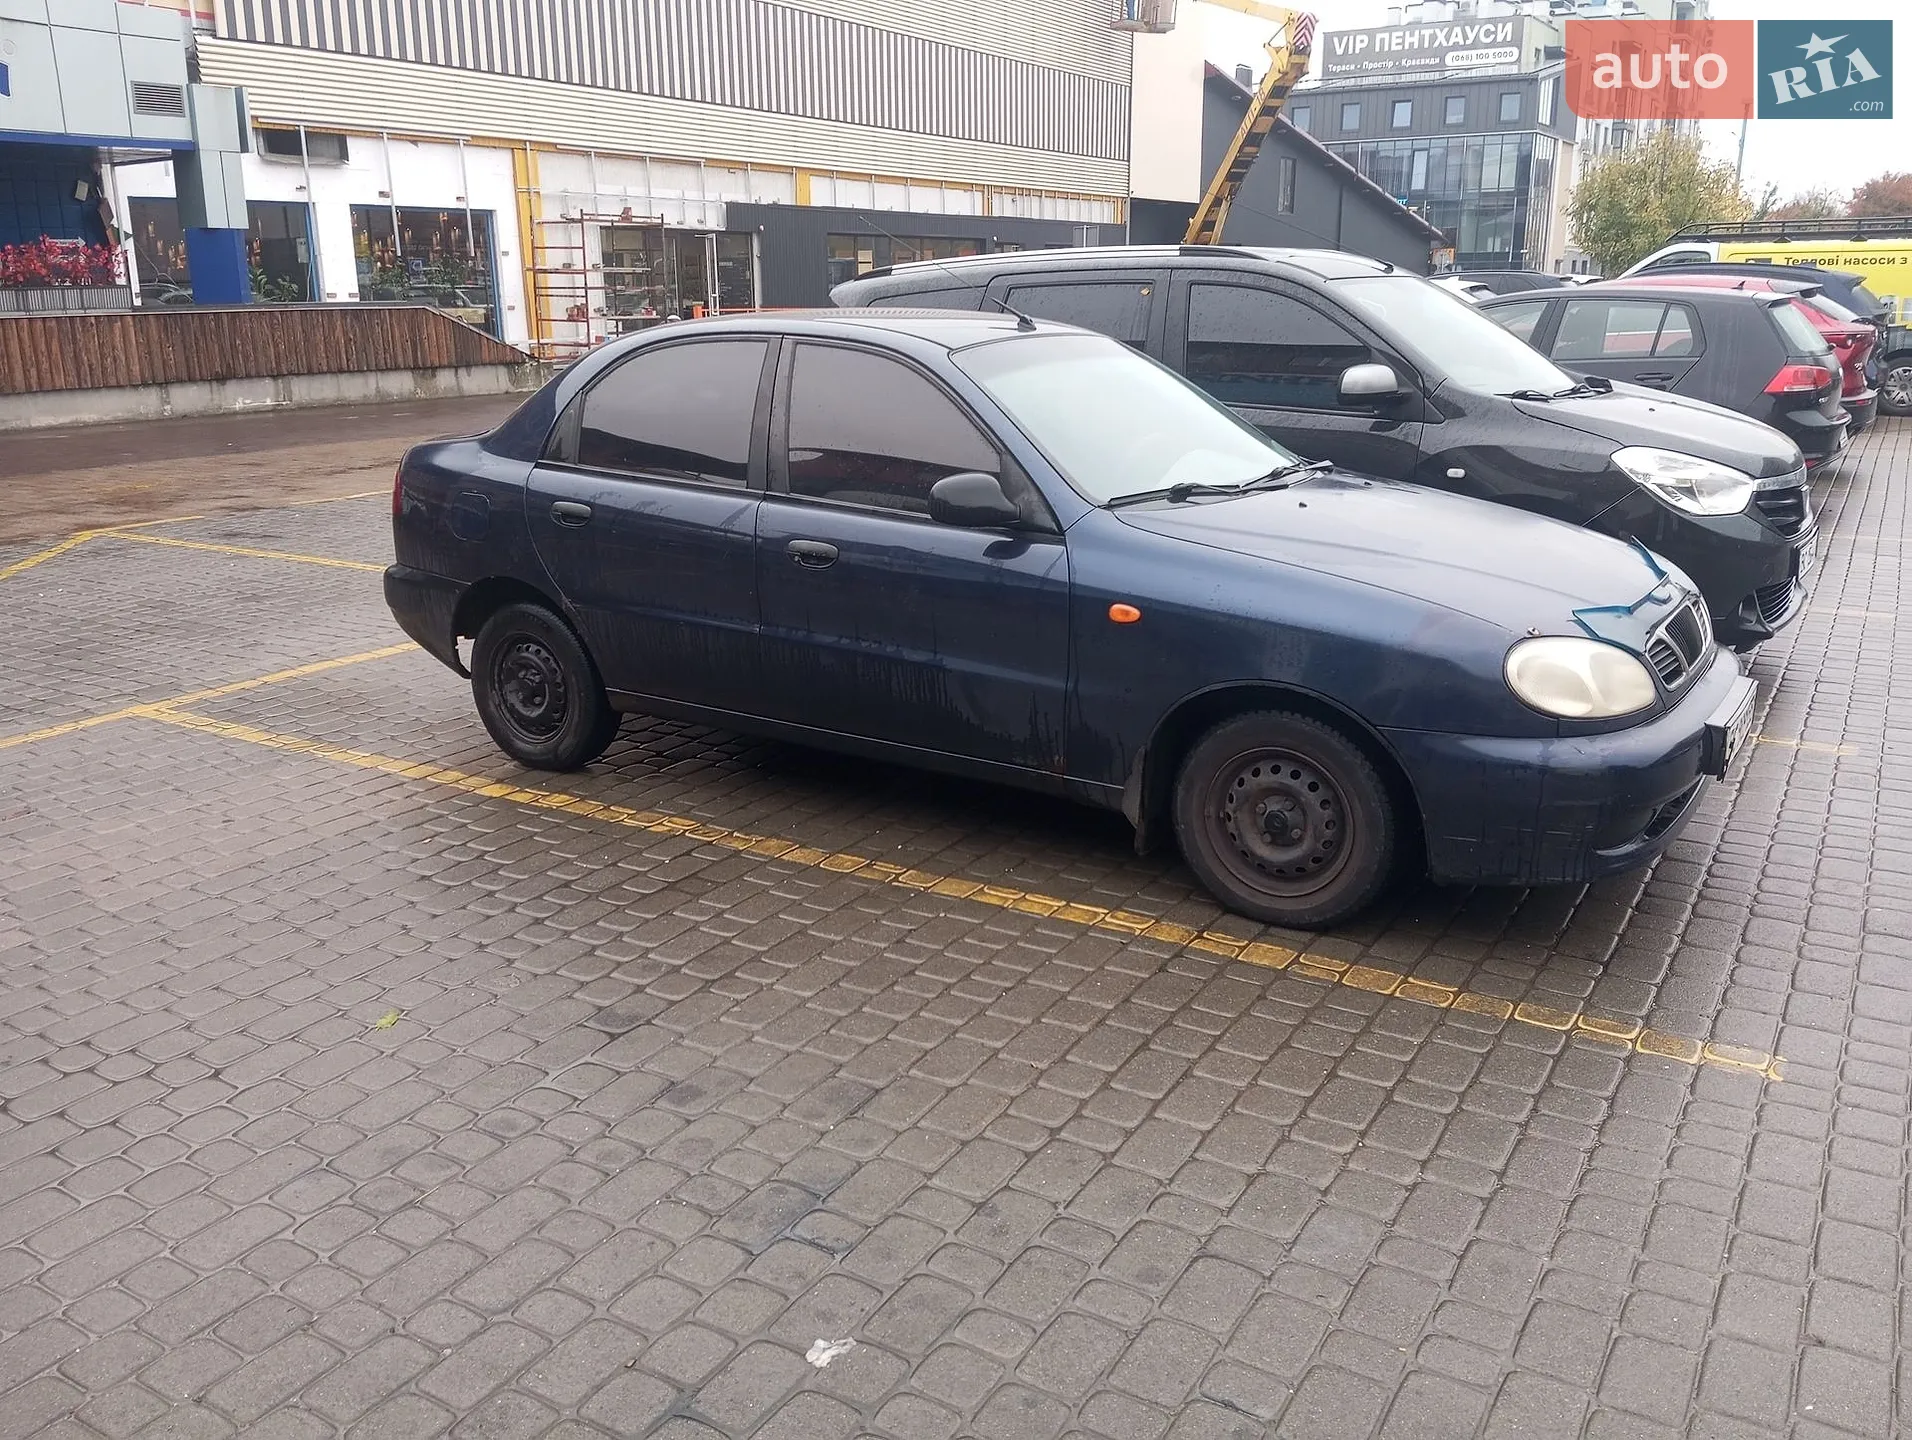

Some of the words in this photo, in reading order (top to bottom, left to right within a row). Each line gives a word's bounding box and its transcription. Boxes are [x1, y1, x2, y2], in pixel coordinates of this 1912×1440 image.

[1333, 34, 1368, 55] VIP
[1375, 22, 1513, 52] ПЕНТХАУСИ
[1476, 52, 1489, 60] 100
[1844, 257, 1895, 265] насоси
